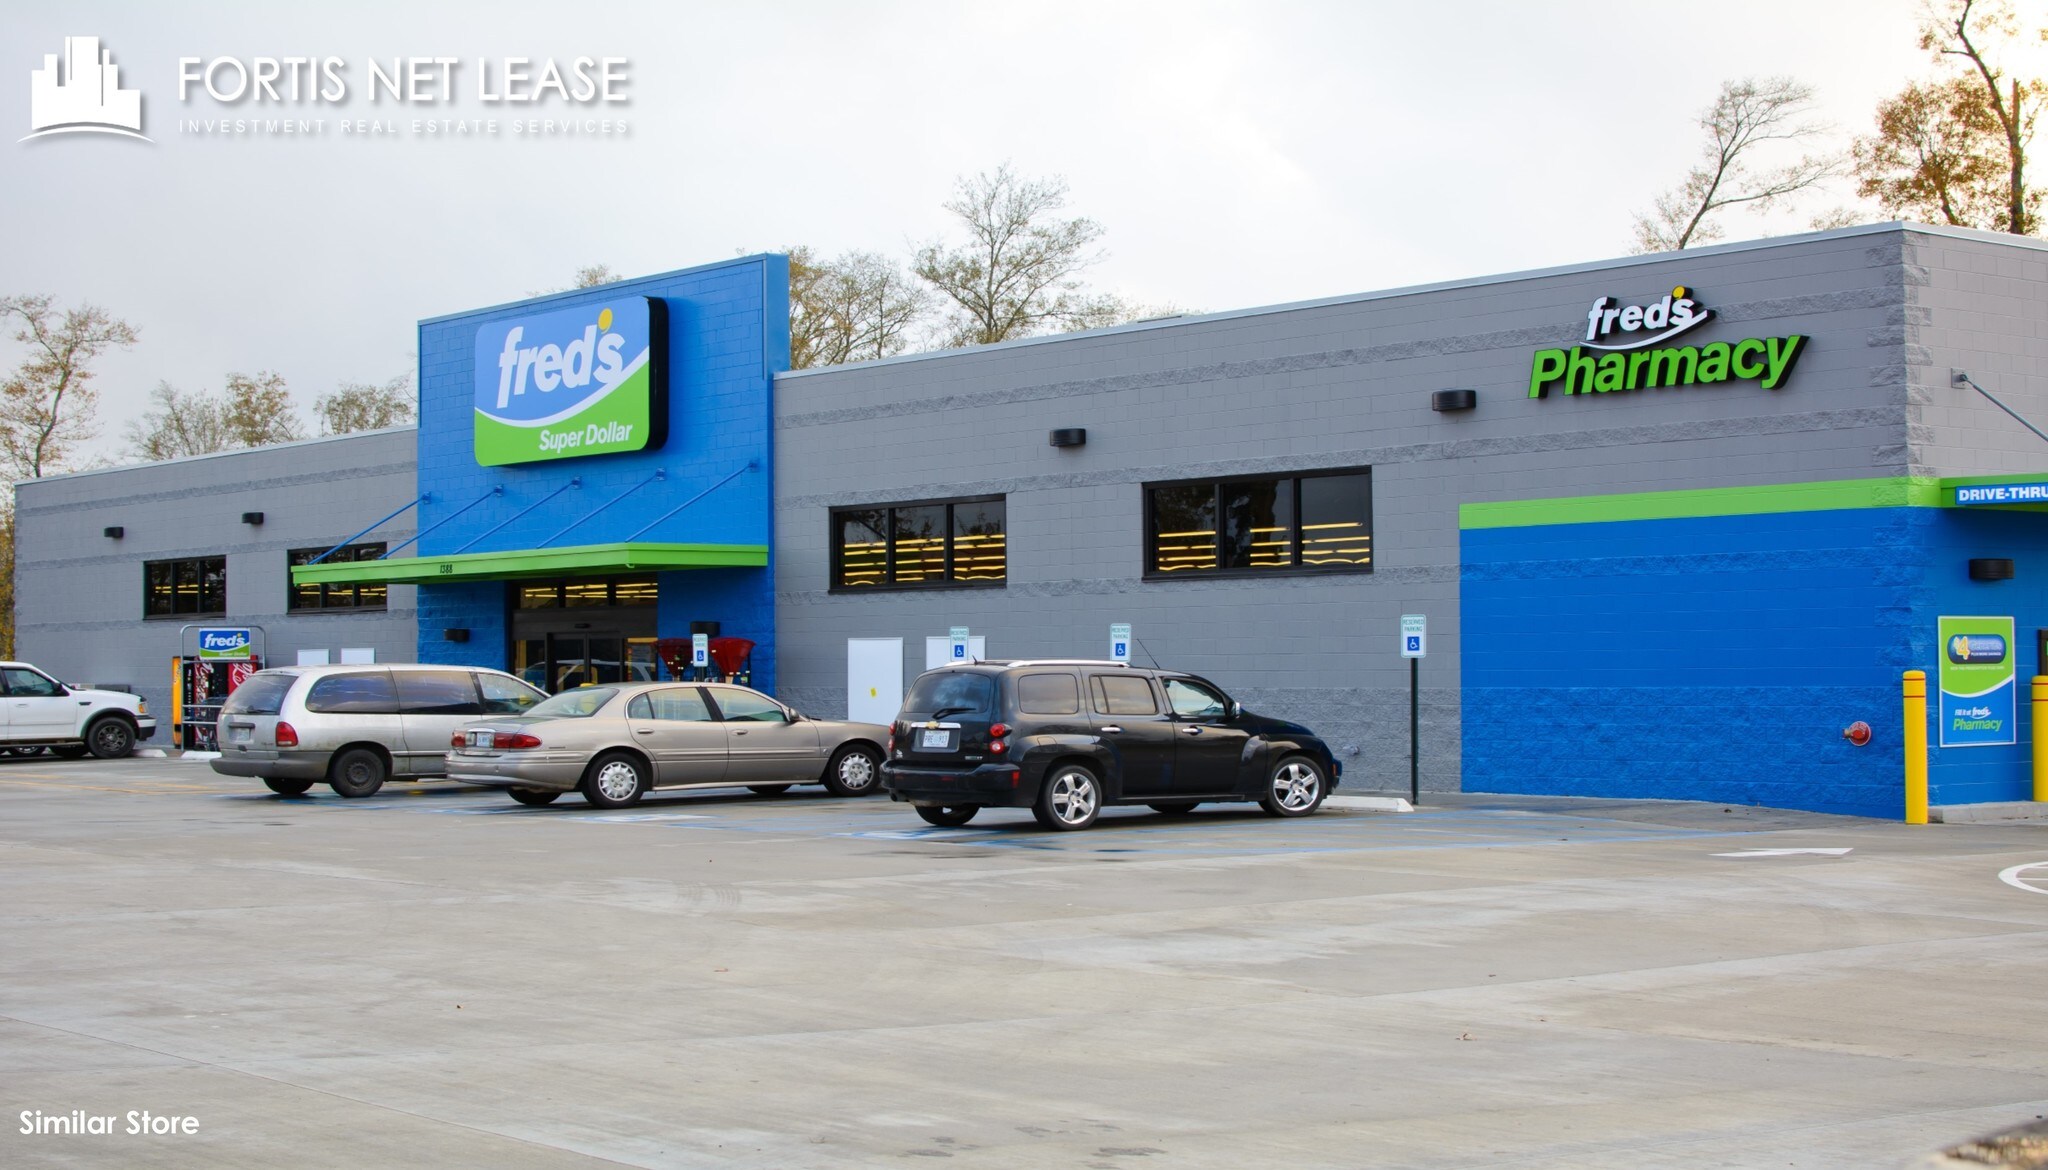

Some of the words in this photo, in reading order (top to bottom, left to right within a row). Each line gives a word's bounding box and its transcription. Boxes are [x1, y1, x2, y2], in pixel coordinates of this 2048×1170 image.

[1585, 285, 1700, 341] fred's
[496, 308, 626, 409] fred's
[1528, 335, 1803, 399] Pharmacy
[539, 429, 584, 454] Super
[585, 421, 633, 446] Dollar
[1959, 486, 2048, 501] DRIVE-THRU
[205, 633, 245, 648] fred's
[1953, 718, 2002, 731] Pharmacy
